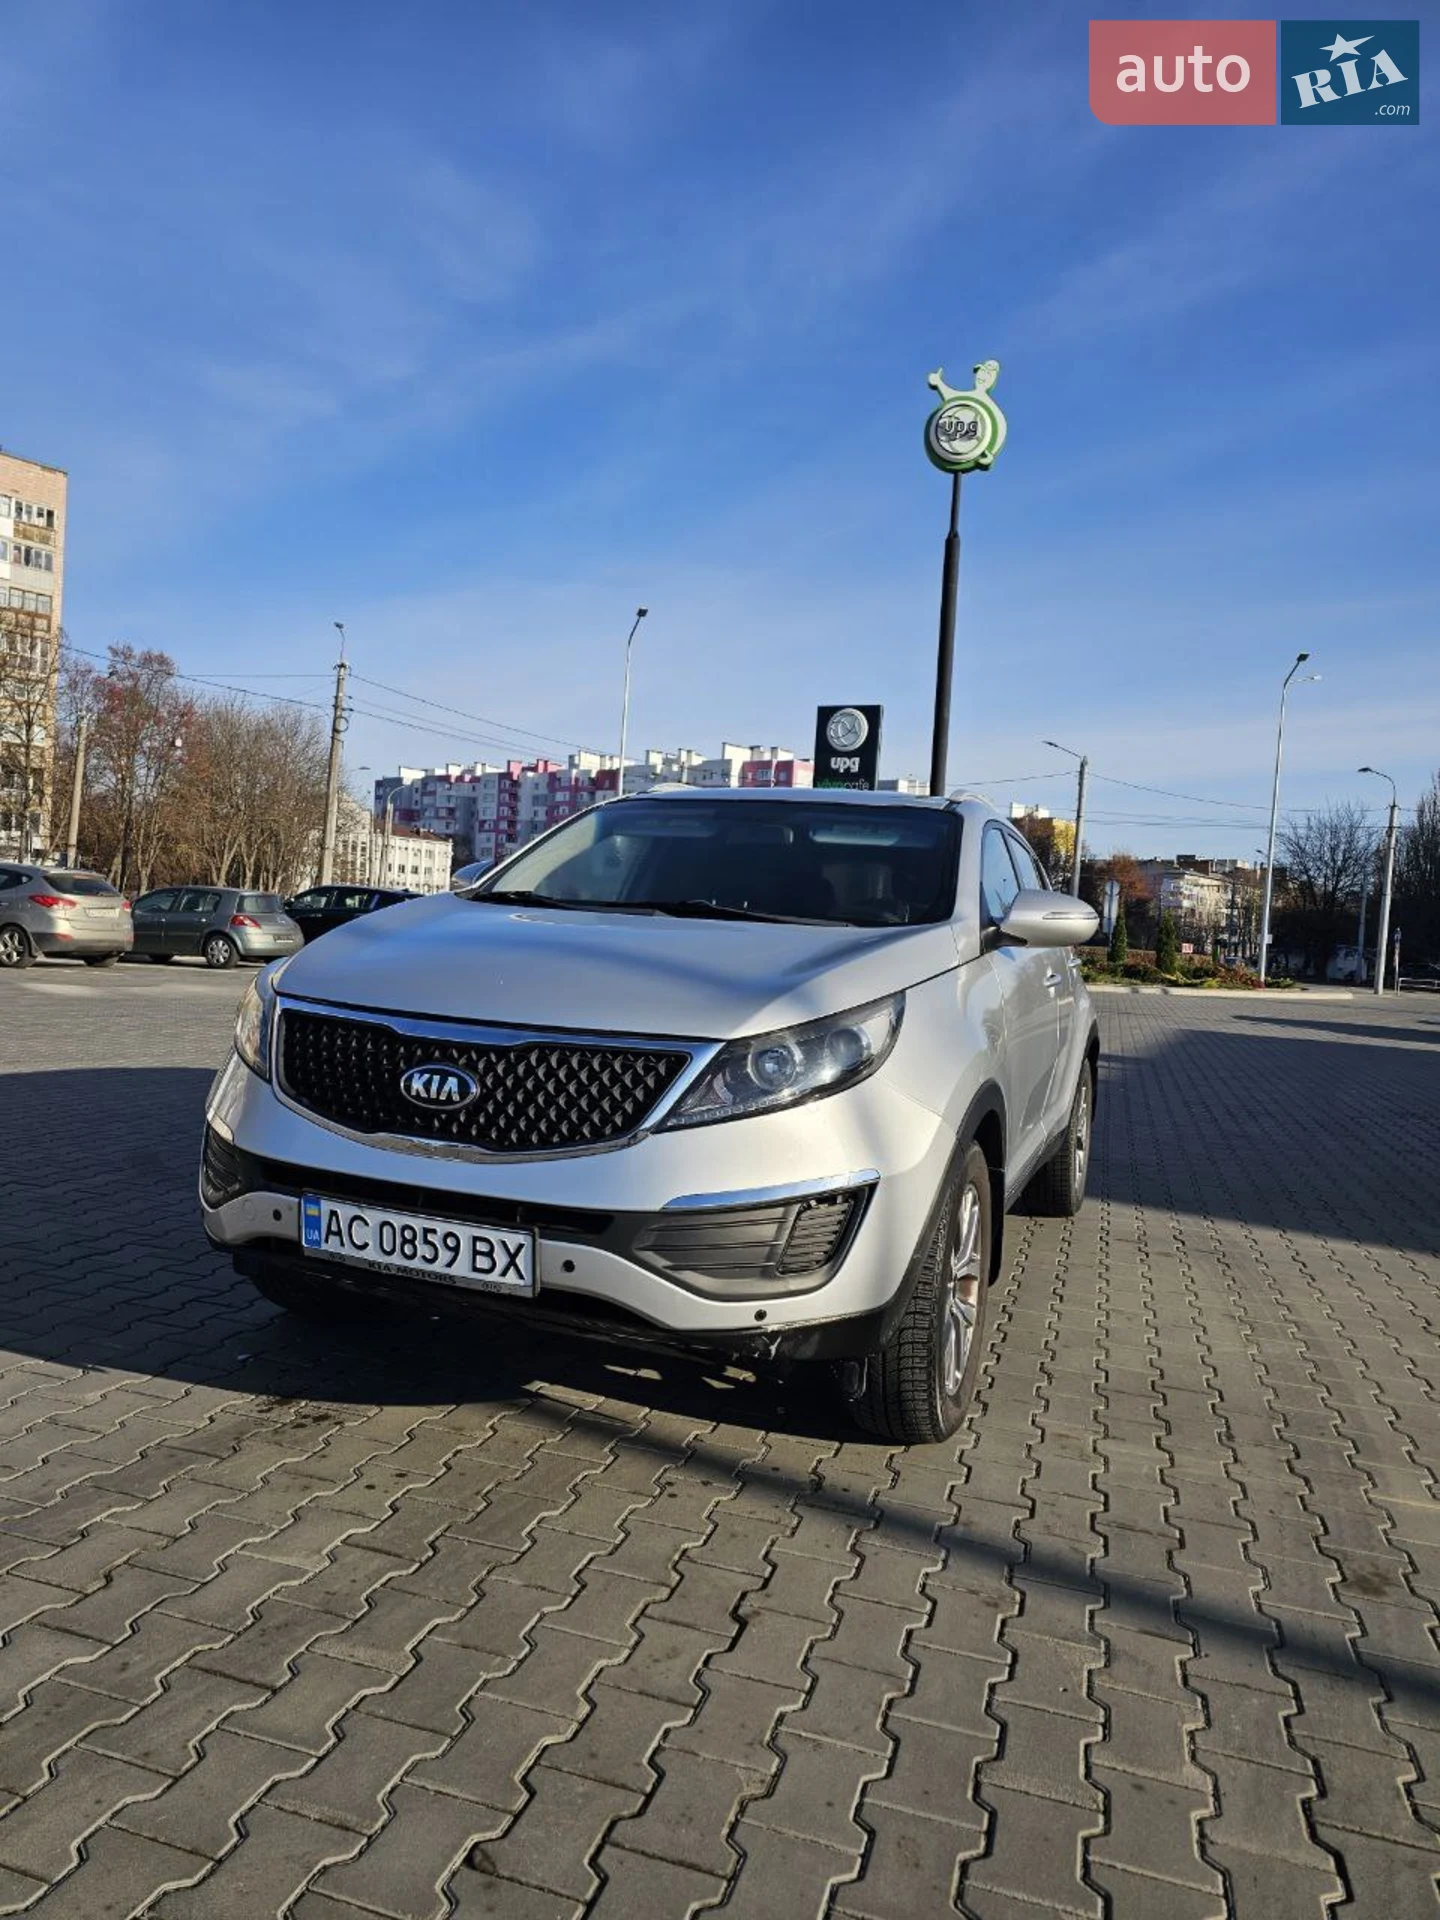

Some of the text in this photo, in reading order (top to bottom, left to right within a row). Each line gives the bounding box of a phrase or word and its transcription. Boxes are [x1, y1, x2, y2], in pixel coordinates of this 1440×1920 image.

[830, 756, 860, 773] upg
[410, 1072, 460, 1102] KIA
[305, 1228, 321, 1241] UA
[324, 1209, 526, 1281] AC 0859 BX
[396, 1265, 457, 1285] MOTORS
